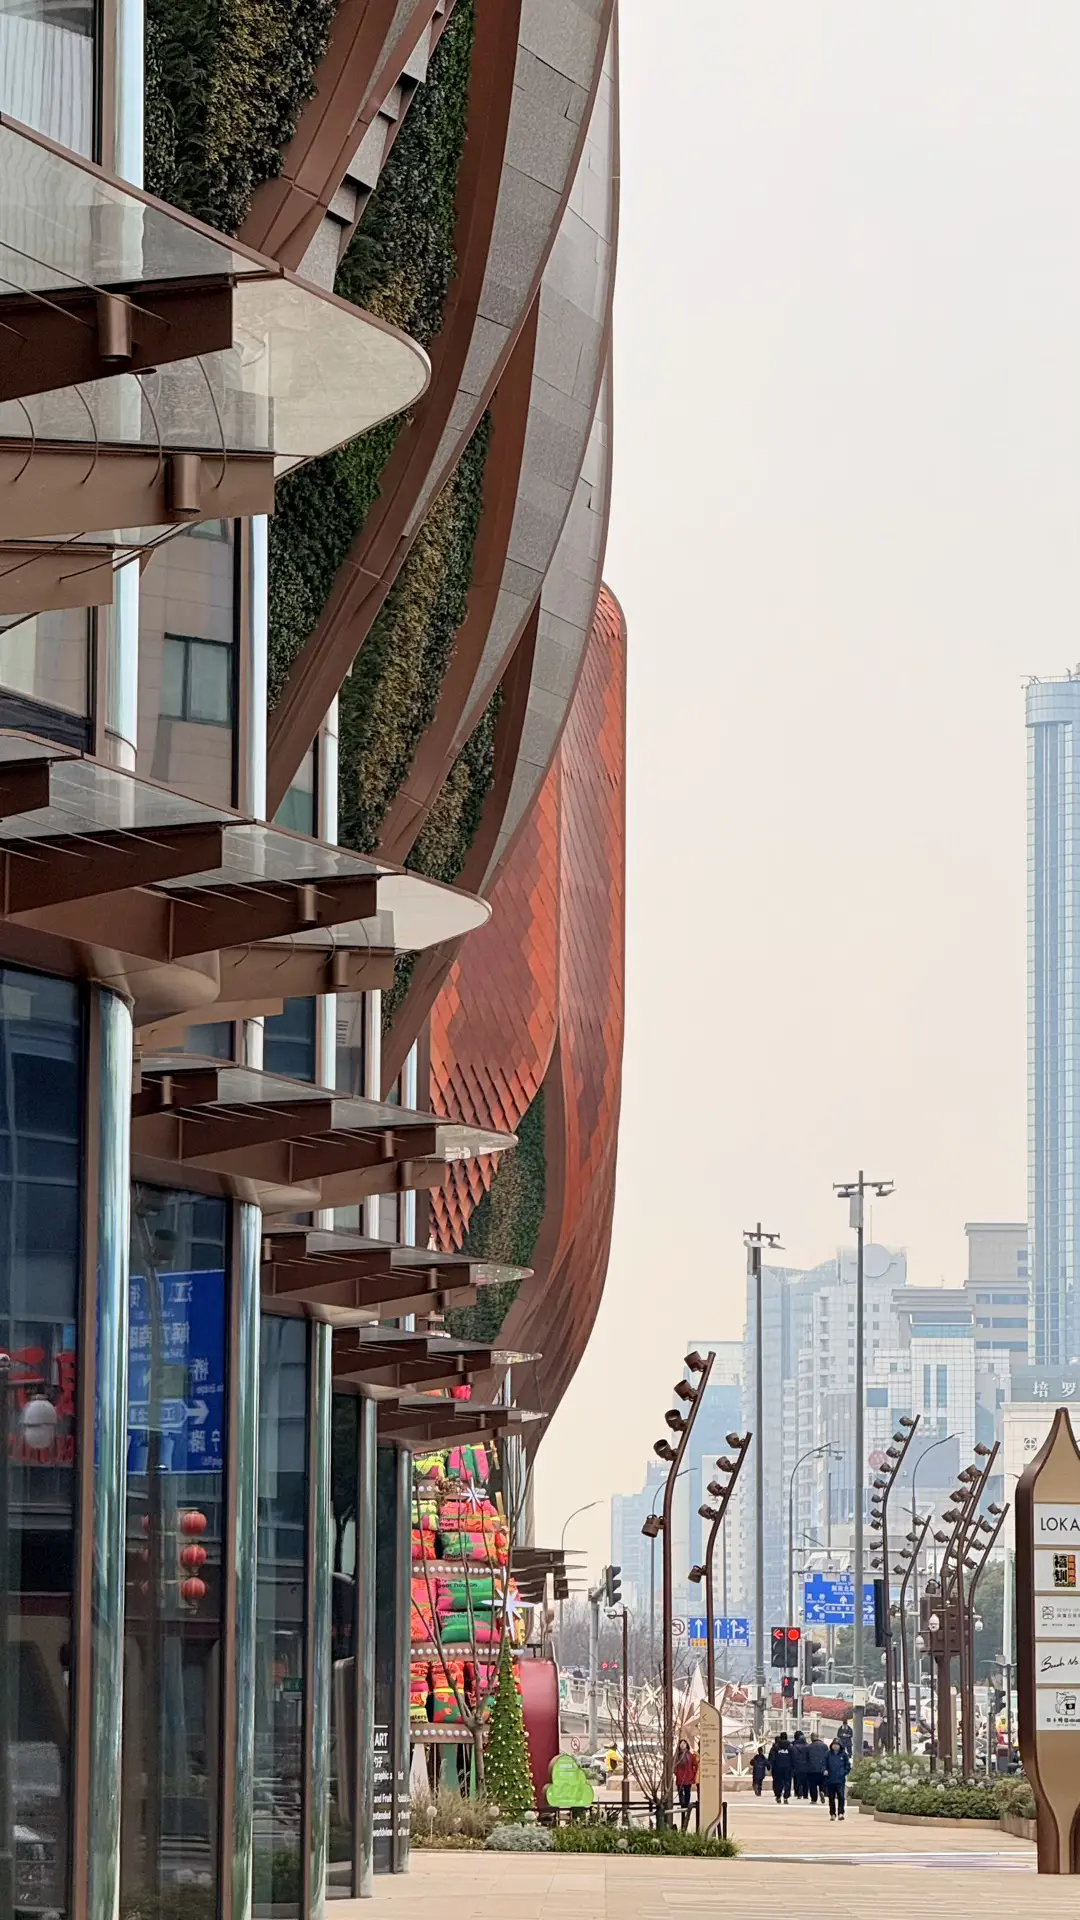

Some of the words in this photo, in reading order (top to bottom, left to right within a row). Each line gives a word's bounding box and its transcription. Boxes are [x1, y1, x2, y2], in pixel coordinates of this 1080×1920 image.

[1032, 1380, 1077, 1398] 培罗
[1040, 1517, 1080, 1532] LOKA
[374, 1732, 388, 1746] ART
